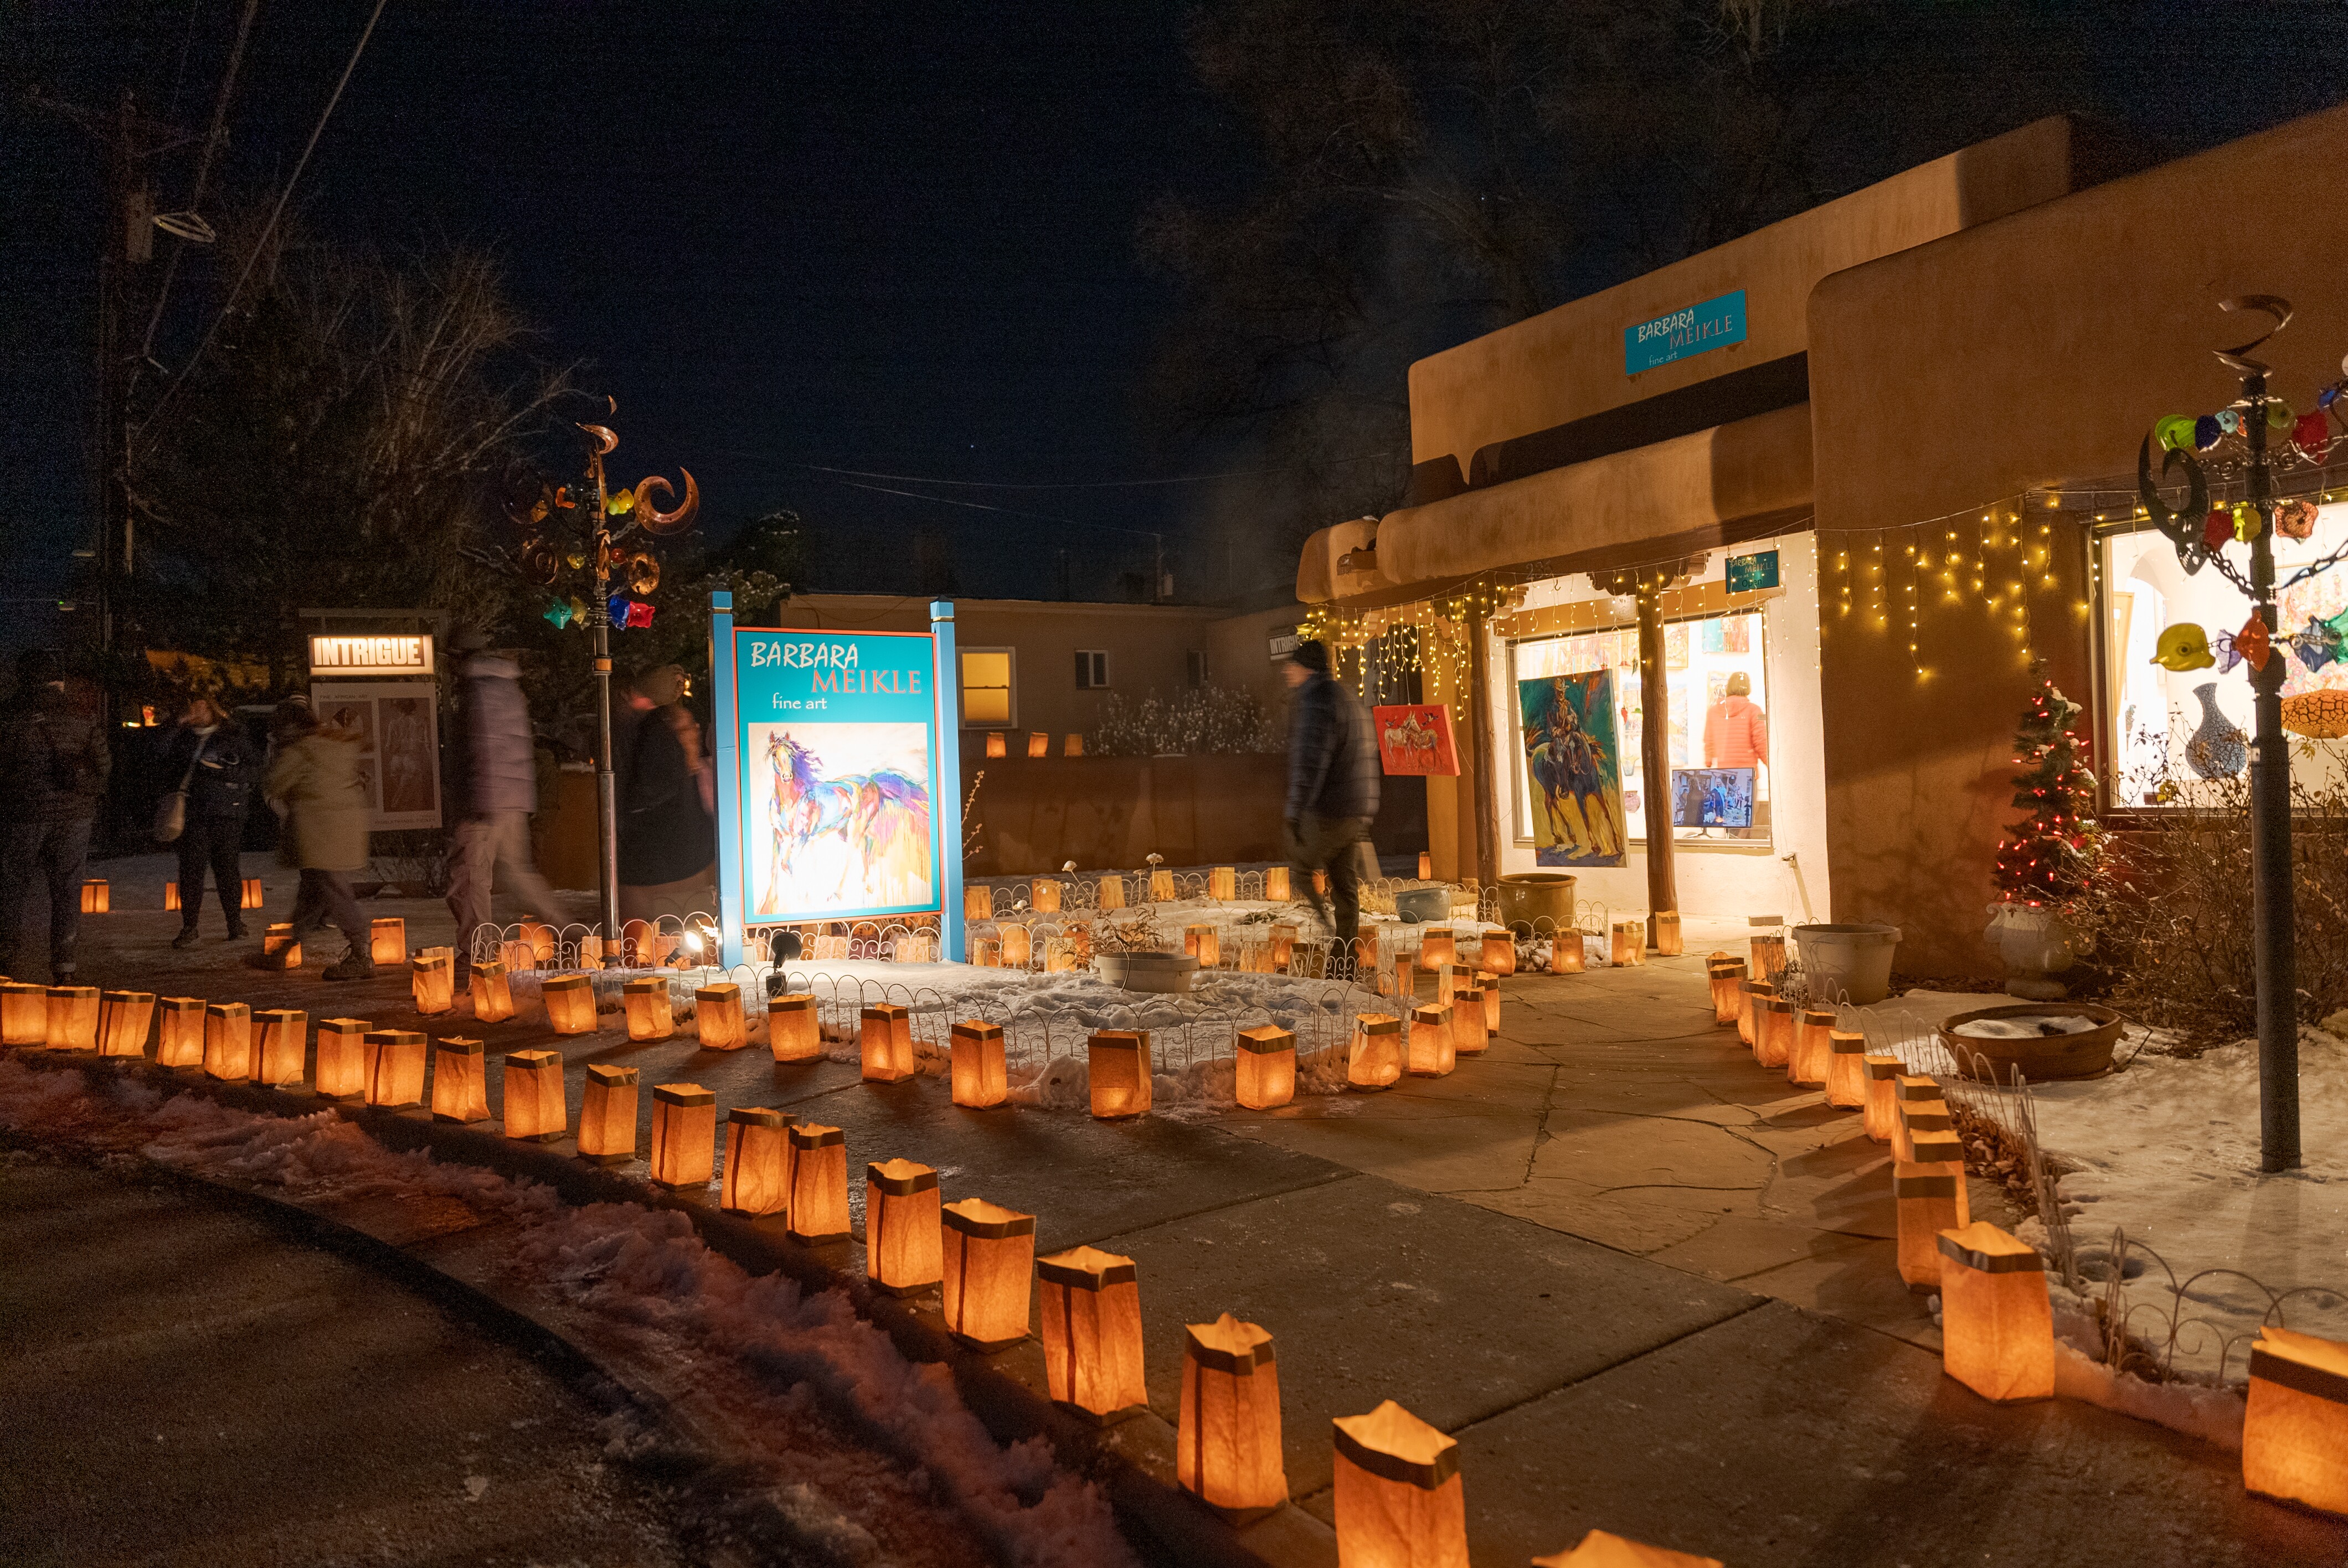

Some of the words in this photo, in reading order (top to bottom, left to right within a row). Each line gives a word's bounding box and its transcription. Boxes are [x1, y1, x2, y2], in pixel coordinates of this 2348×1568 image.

[1638, 308, 1694, 343] BARBARA
[1669, 314, 1733, 350] MEIKLE
[1649, 355, 1664, 366] fine
[1666, 350, 1678, 361] art
[1745, 561, 1774, 573] MEIKLE
[1742, 579, 1762, 588] Open
[313, 637, 421, 666] INTRIGUE
[751, 641, 858, 670] BARBARA
[811, 668, 921, 694] MEIKLE
[772, 692, 802, 709] fine
[805, 697, 828, 709] art
